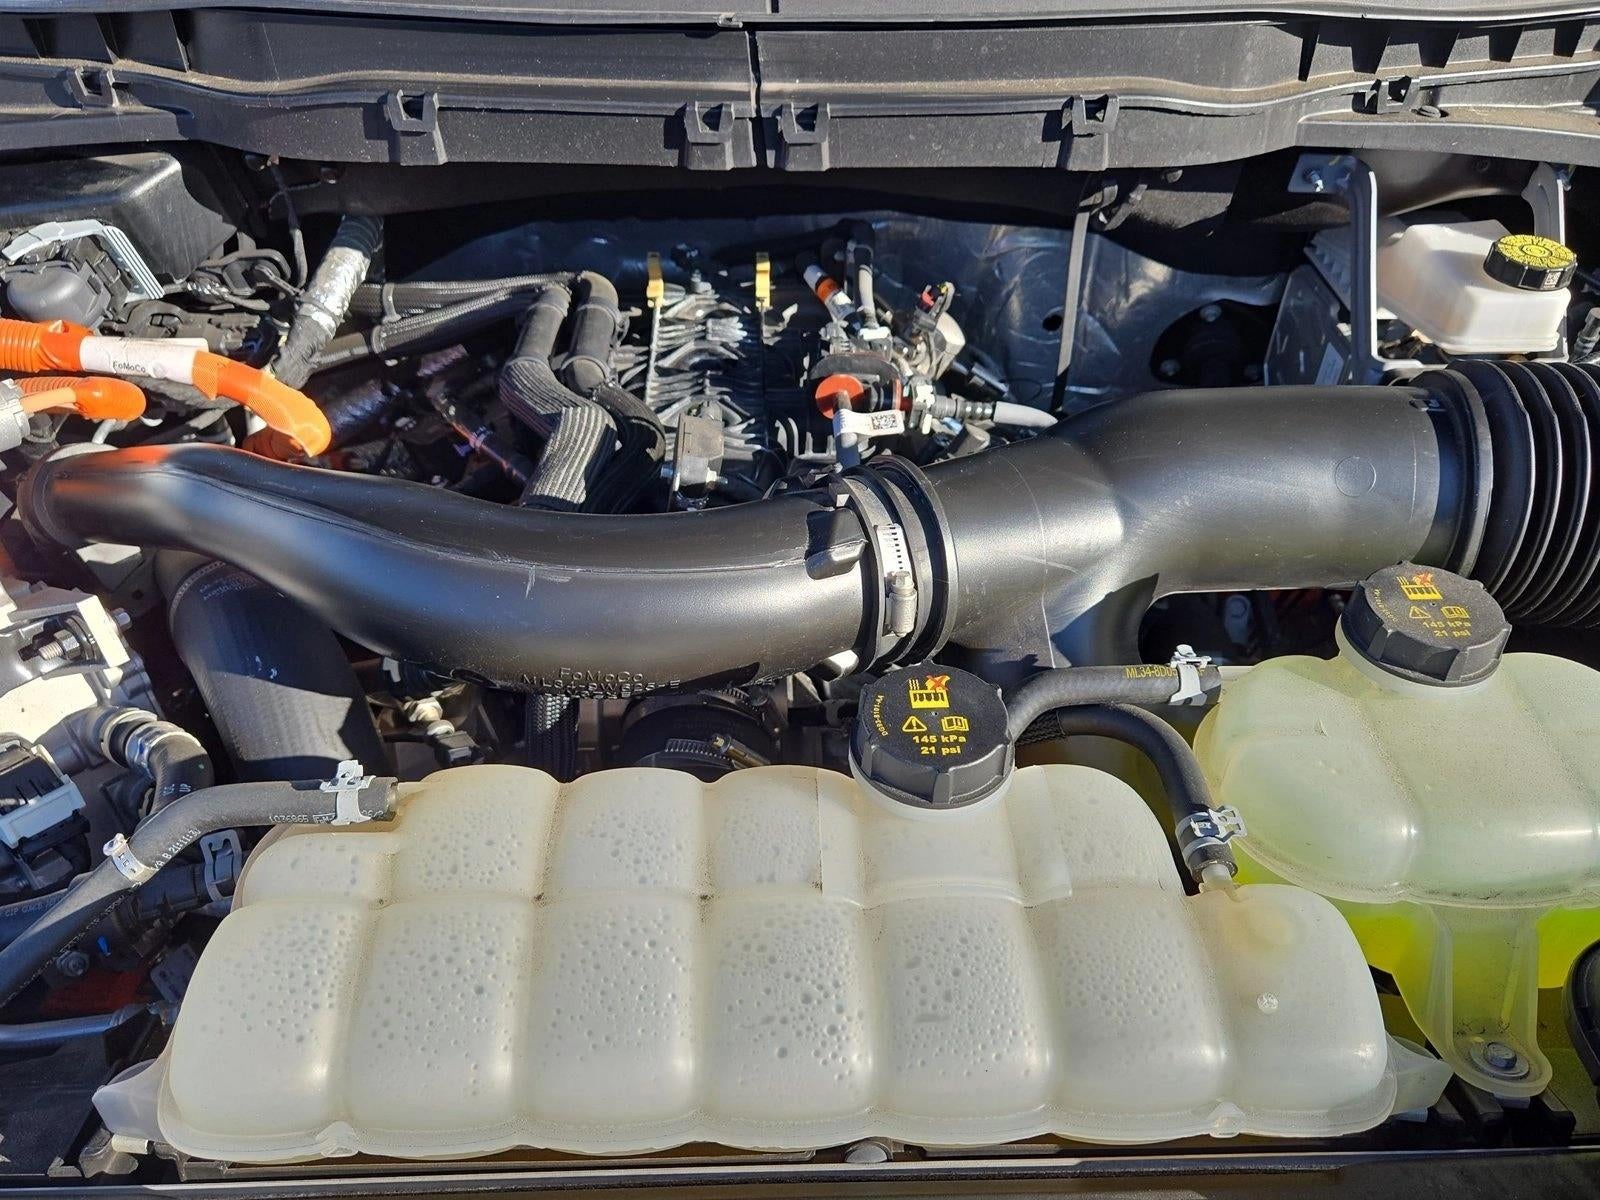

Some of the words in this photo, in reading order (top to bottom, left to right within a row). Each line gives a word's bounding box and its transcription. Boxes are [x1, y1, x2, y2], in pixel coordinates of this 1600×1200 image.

[113, 361, 146, 373] FoMoCo
[1453, 630, 1471, 638] psi
[560, 667, 643, 682] FoMoCo
[912, 735, 938, 743] 145
[941, 735, 967, 743] kPa
[920, 746, 936, 755] 21
[941, 746, 962, 756] psi
